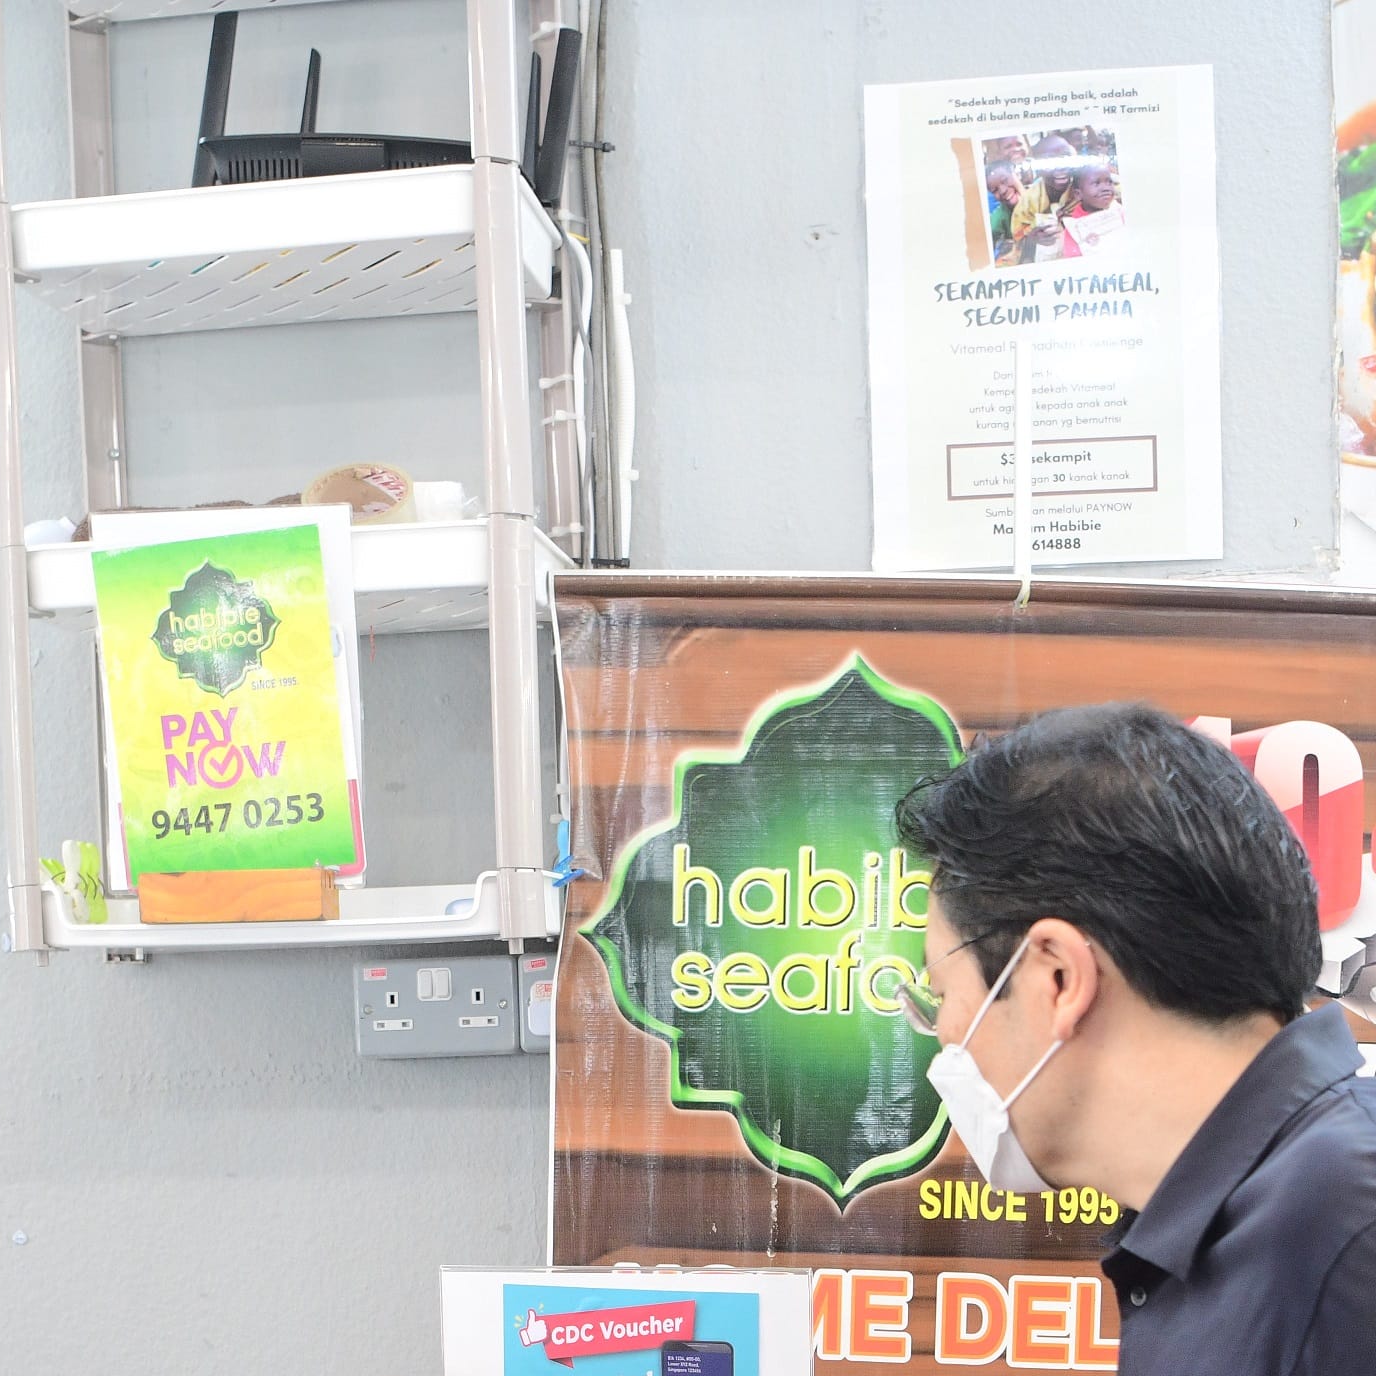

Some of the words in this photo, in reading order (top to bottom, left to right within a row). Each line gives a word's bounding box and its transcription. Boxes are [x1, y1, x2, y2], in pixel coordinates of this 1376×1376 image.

[1004, 95, 1031, 107] yang
[1034, 92, 1068, 104] paling
[1100, 88, 1138, 99] adalah
[928, 114, 974, 126] sedekah
[977, 111, 987, 122] di
[990, 110, 1021, 121] bulan
[1023, 107, 1080, 119] Ramadhan
[1103, 105, 1117, 115] HR
[1120, 103, 1160, 114] Tarmizi
[933, 278, 1042, 302] SEKAMPIT
[963, 305, 1041, 328] SEGUNI
[950, 341, 1006, 355] Vitameal
[969, 404, 995, 414] untuk
[1036, 400, 1074, 412] kepada
[1076, 398, 1100, 409] anak
[1104, 397, 1128, 407] anak
[976, 419, 1009, 431] kurang
[973, 476, 1000, 487] untuk
[1052, 473, 1066, 483] 30
[1069, 471, 1097, 481] kanak
[1101, 470, 1130, 480] kanak
[1048, 503, 1084, 515] melalui
[1086, 502, 1133, 513] PAYNOW
[1050, 520, 1102, 533] Habibie
[173, 621, 264, 655] seafood
[251, 679, 276, 691] SINCE
[160, 706, 239, 750] PAY
[165, 741, 287, 789] NOW
[151, 802, 232, 840] 9447
[243, 792, 325, 829] 0253
[672, 843, 933, 930] habib
[918, 1179, 1028, 1222] SINCE
[551, 1323, 594, 1345] CDC
[599, 1315, 683, 1340] Voucher
